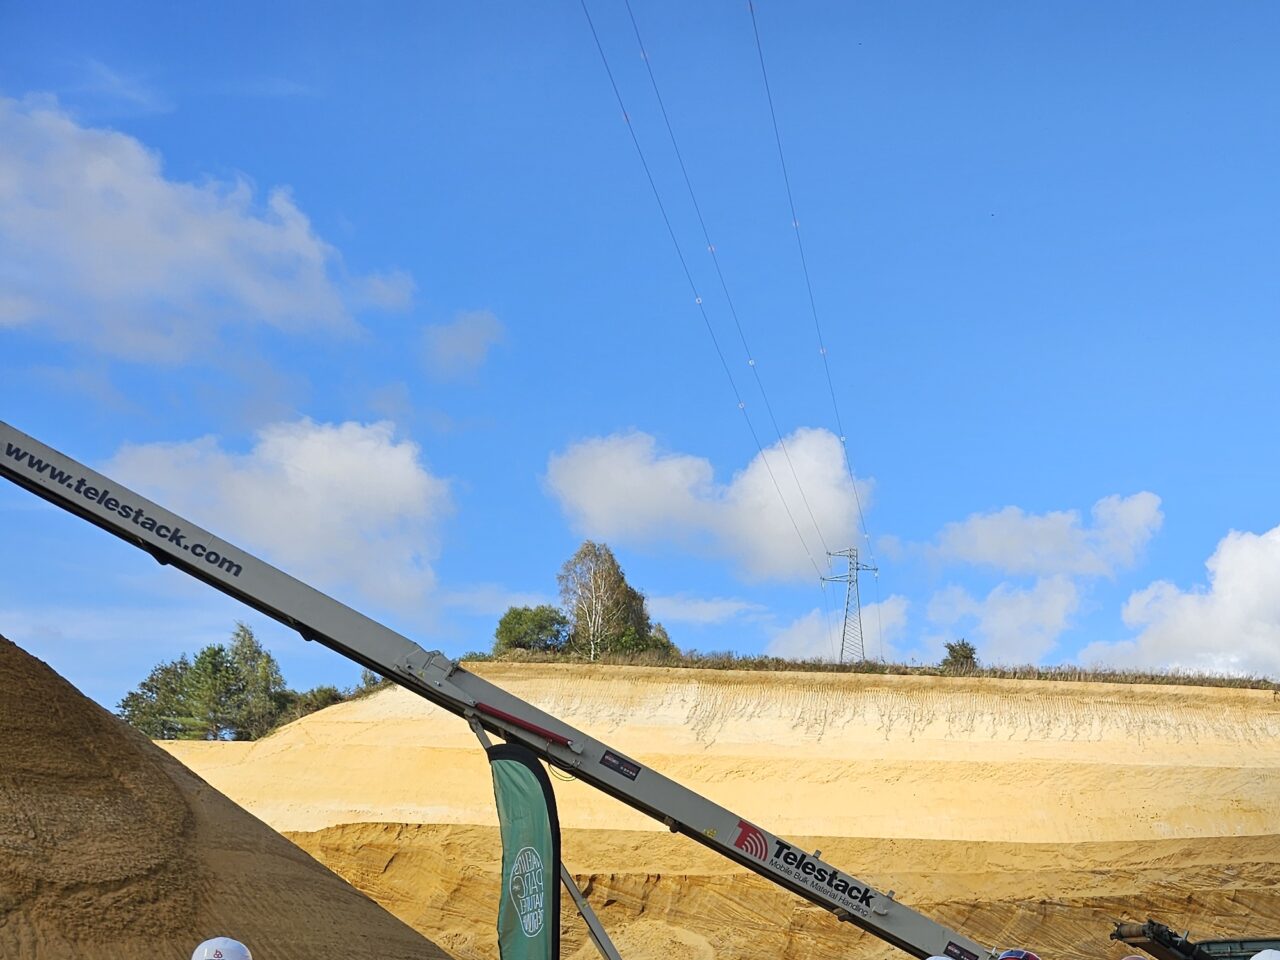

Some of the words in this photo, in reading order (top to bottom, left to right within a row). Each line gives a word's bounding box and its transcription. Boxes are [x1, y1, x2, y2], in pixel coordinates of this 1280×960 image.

[6, 443, 243, 577] www.telestack.com
[769, 858, 793, 876] Mobile
[793, 872, 808, 886] Bulk
[809, 881, 838, 902] Material
[839, 896, 869, 918] Handling
[773, 840, 877, 908] Telestack
